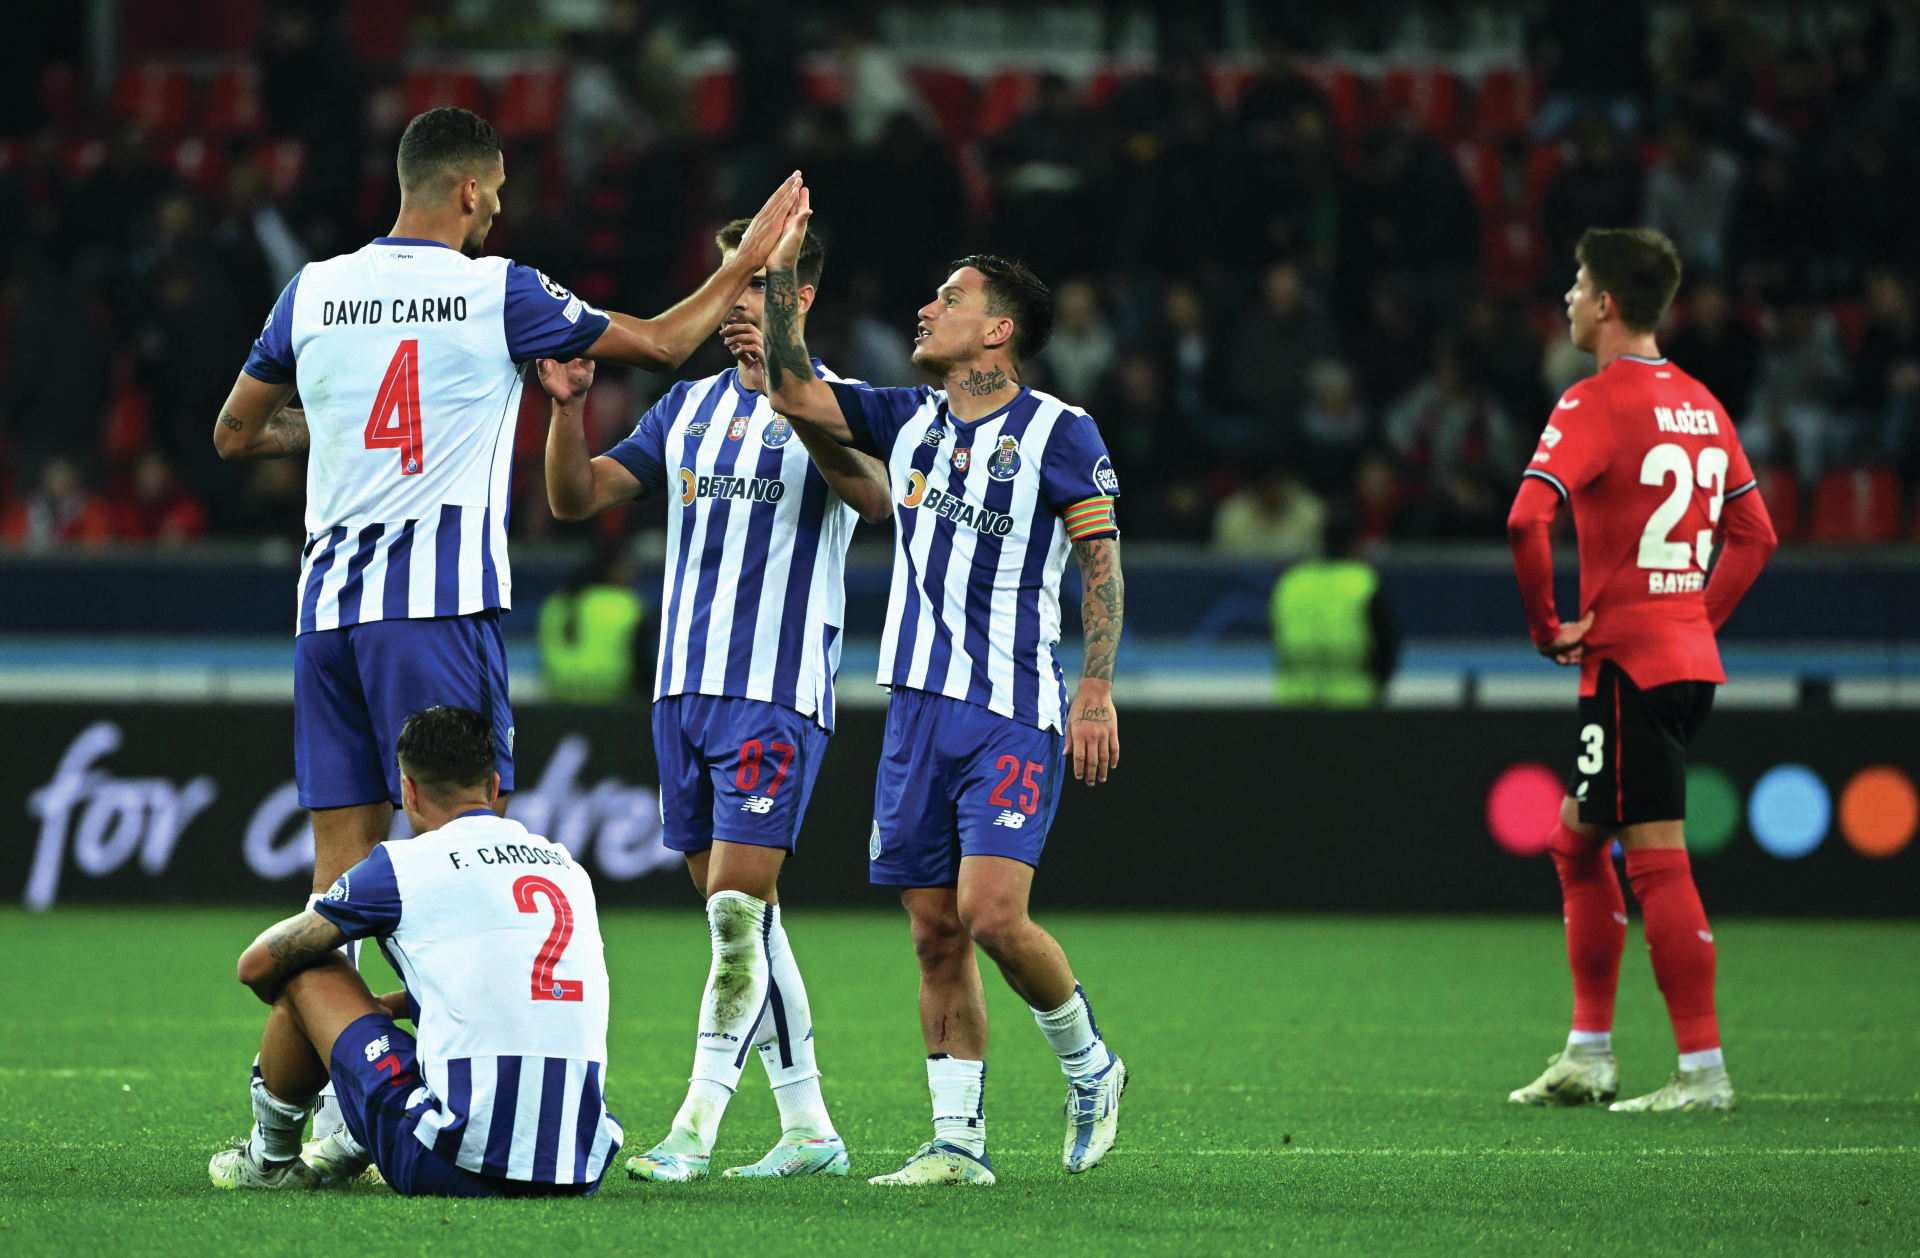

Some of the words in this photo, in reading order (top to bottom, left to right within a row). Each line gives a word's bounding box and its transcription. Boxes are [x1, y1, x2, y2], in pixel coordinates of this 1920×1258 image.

[323, 300, 382, 326] DAVID
[392, 296, 467, 323] CARMO
[364, 340, 423, 476] 4
[696, 476, 786, 503] BETANO
[922, 487, 1015, 537] BETANO
[1636, 442, 1730, 572] 23
[735, 739, 795, 796] 87
[1577, 723, 1604, 775] 3
[988, 754, 1044, 815] 25
[27, 722, 216, 912] for
[449, 851, 469, 869] F.
[512, 875, 584, 1002] 2
